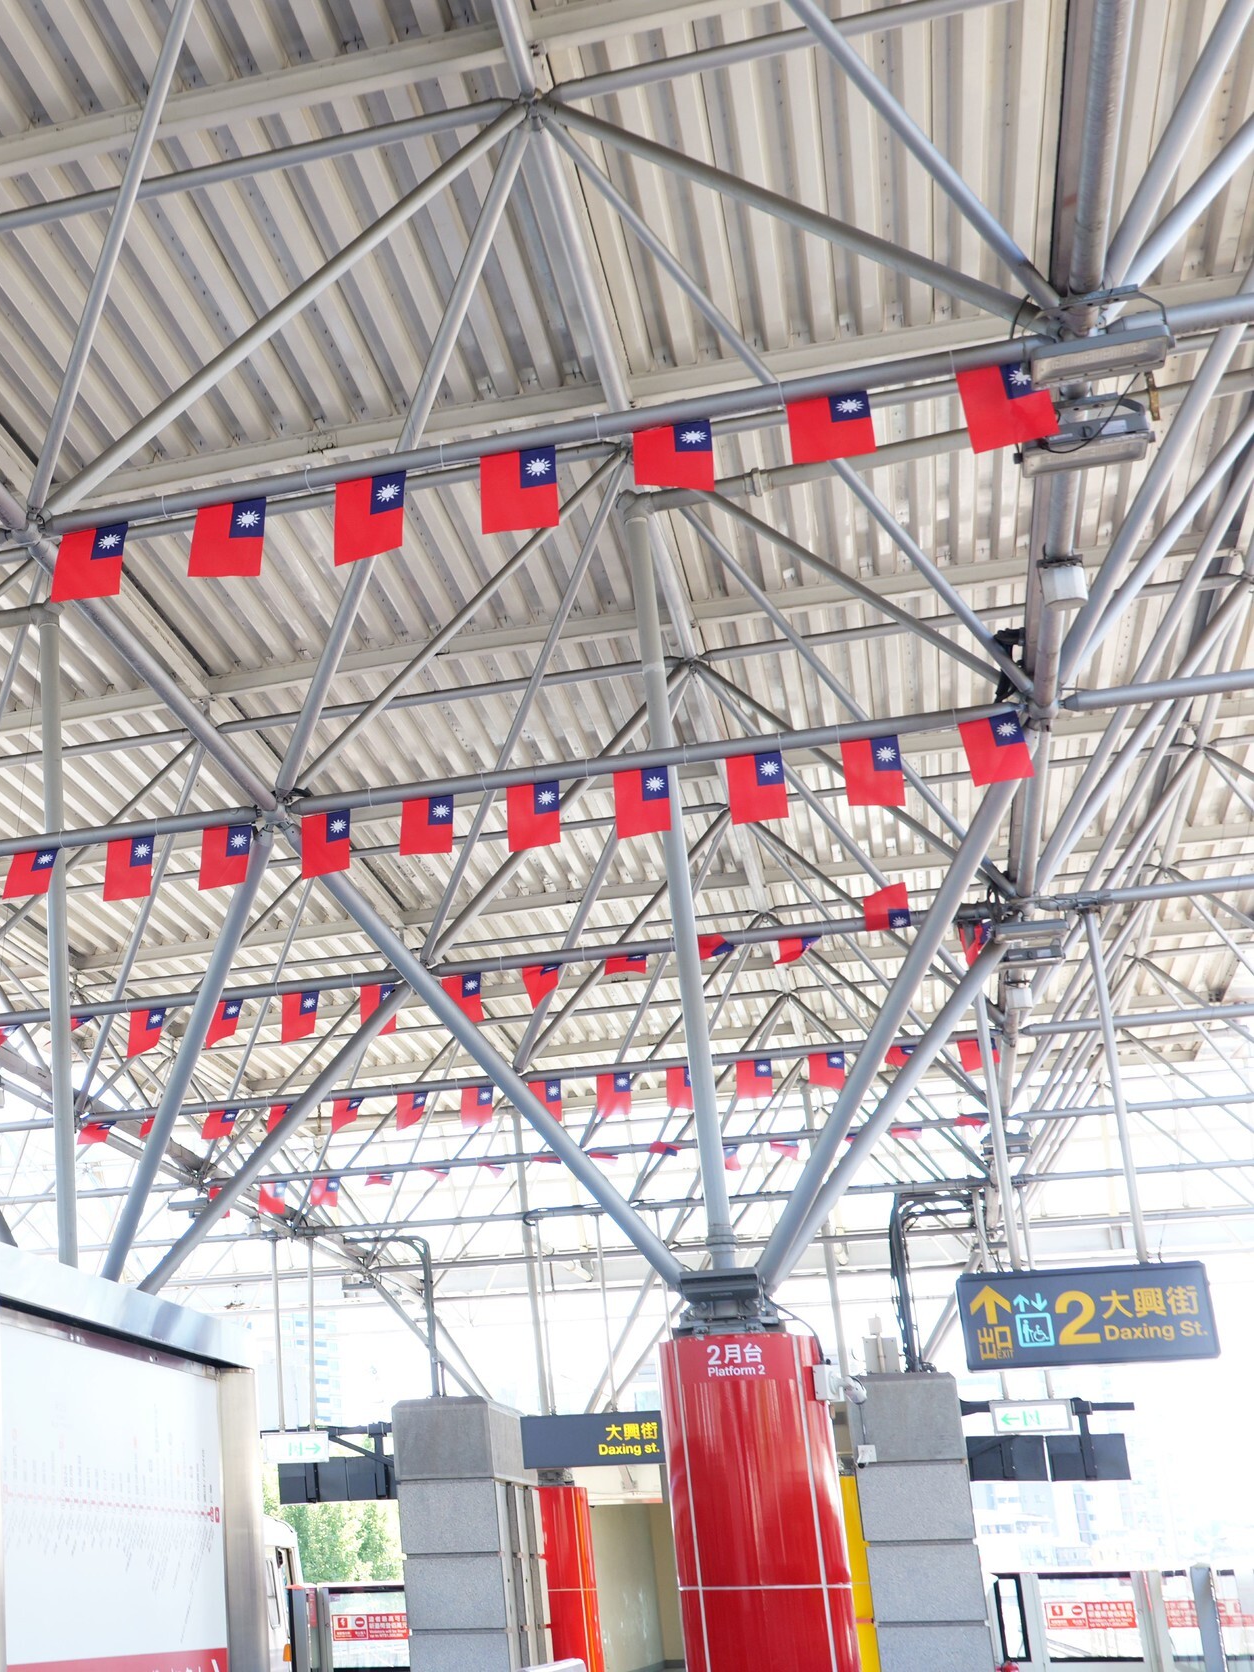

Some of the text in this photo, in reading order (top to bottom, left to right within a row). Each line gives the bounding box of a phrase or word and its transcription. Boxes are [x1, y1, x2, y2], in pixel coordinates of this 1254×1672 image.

[1100, 1285, 1198, 1319] 大興街
[1054, 1290, 1102, 1345] 2
[1103, 1319, 1208, 1341] Daxing St.
[706, 1342, 763, 1366] 2月台
[977, 1325, 1014, 1361] 出口
[996, 1348, 1014, 1359] EXIT
[707, 1364, 766, 1378] Platform 2
[605, 1422, 658, 1441] 大興街
[598, 1442, 660, 1456] Daxing st.
